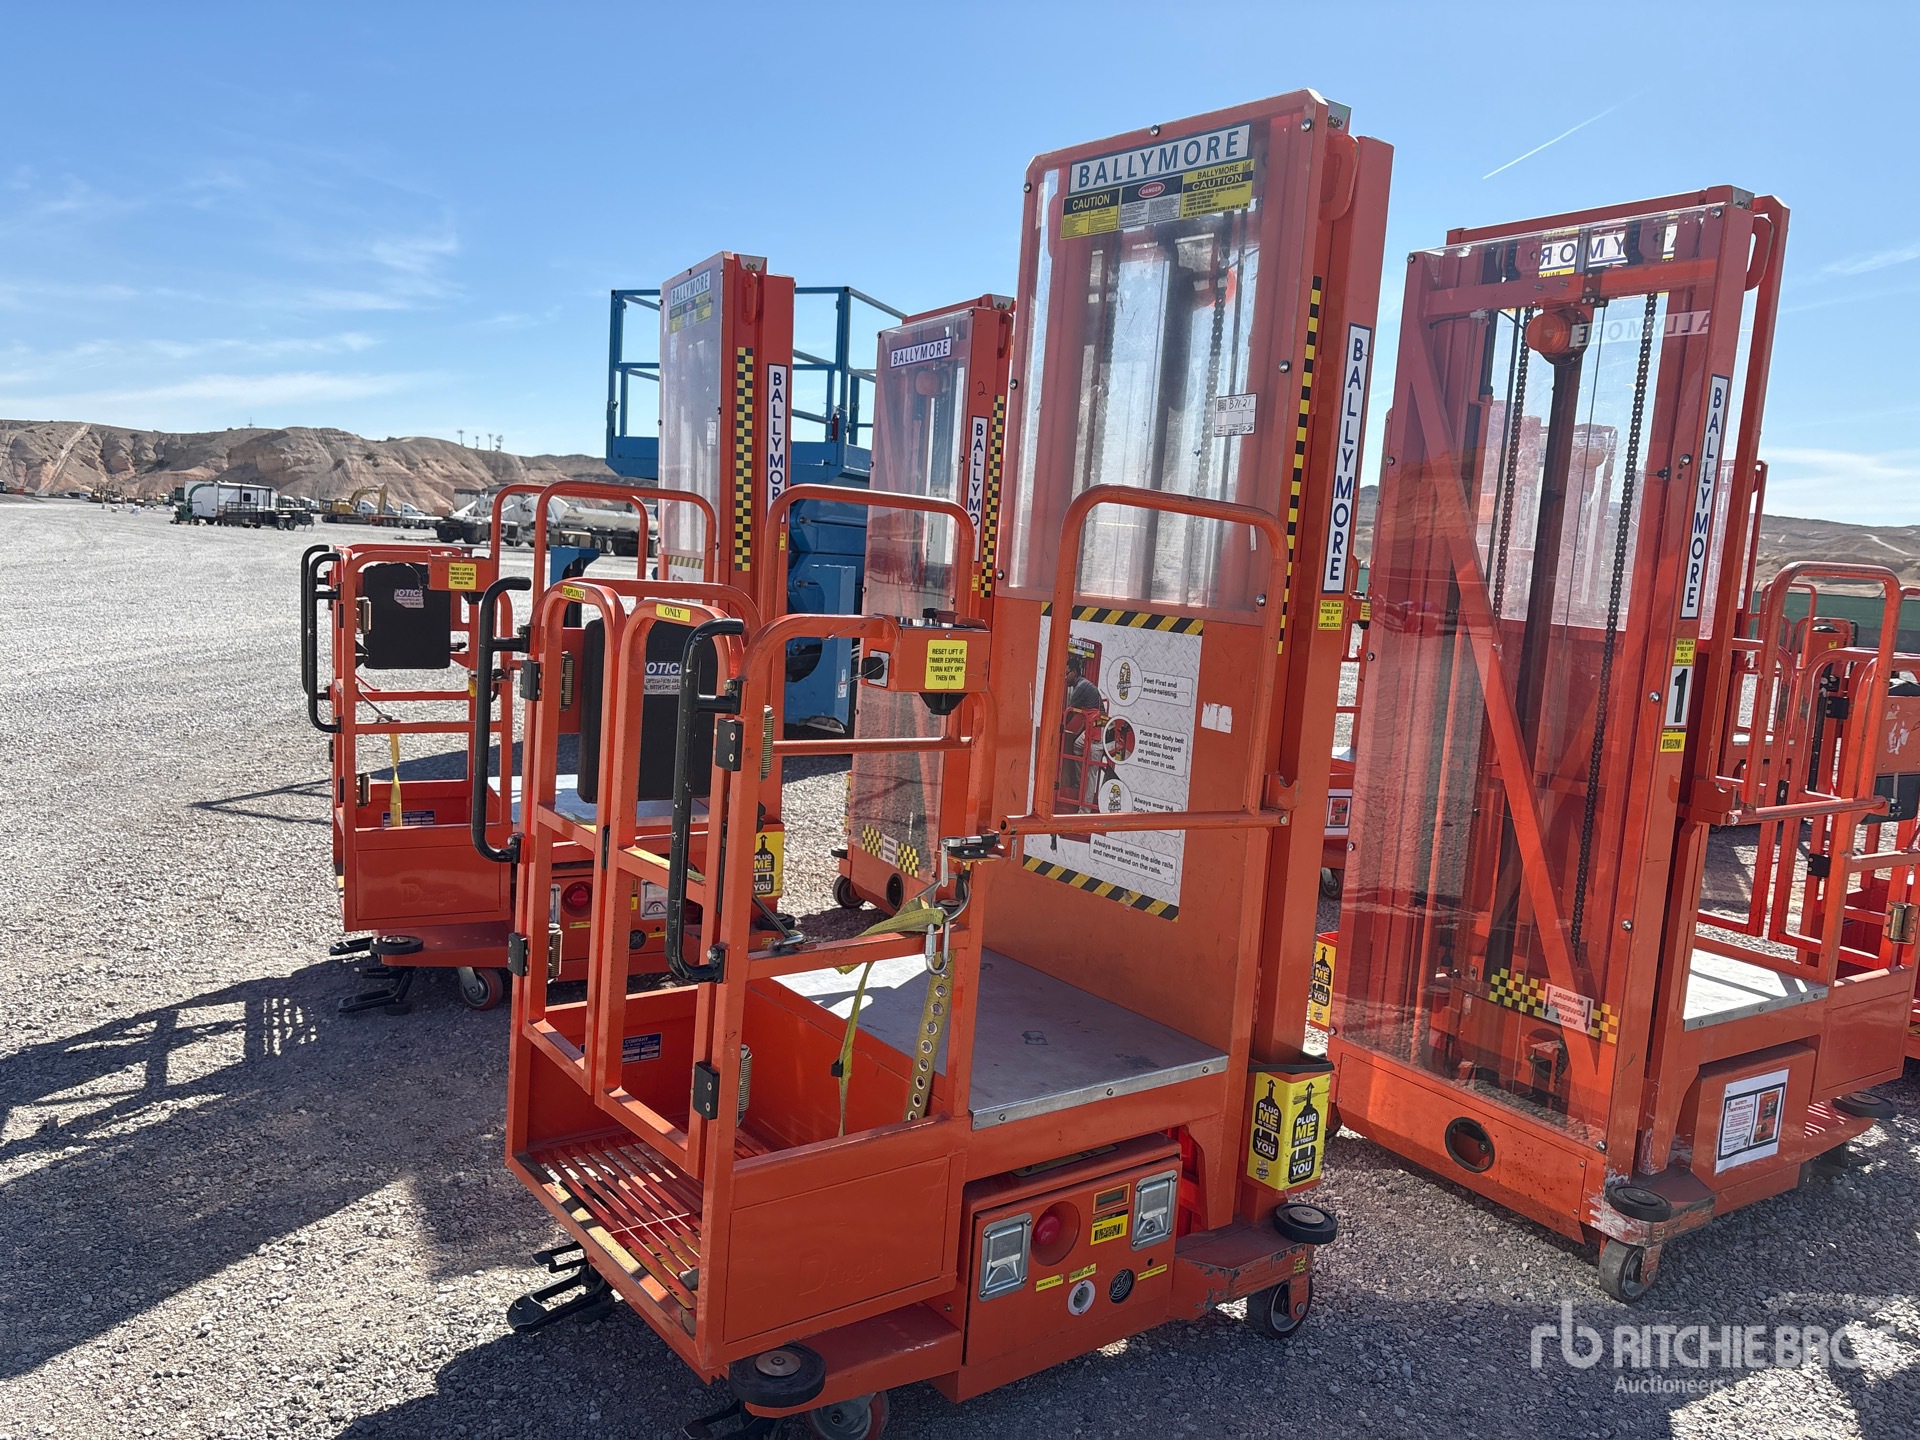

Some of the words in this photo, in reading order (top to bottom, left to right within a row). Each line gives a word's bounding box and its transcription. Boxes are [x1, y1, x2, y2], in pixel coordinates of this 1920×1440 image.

[1078, 130, 1239, 188] BALLYMORE
[1197, 164, 1239, 180] BALLYMORE
[1192, 173, 1243, 191] CAUTION
[1072, 193, 1110, 211] CAUTION
[672, 273, 709, 305] BALLYMORE
[893, 340, 949, 366] BALLYMORE
[977, 381, 988, 396] 2
[770, 371, 784, 500] BALLYMOR
[1329, 337, 1364, 581] BALLYMORE
[969, 423, 984, 527] BALLYMO
[1687, 386, 1722, 609] BALLYMORE
[664, 606, 683, 619] ONLY
[645, 661, 682, 675] OTIC
[1155, 679, 1167, 687] First
[1674, 668, 1688, 723] 1
[1140, 729, 1153, 738] Place
[1162, 734, 1174, 743] body
[1145, 749, 1161, 757] yellow
[1162, 752, 1174, 760] hook
[1149, 741, 1162, 749] static
[1162, 743, 1182, 753] lanyard
[1137, 757, 1150, 765] when
[1134, 796, 1151, 807] Always
[1152, 802, 1164, 810] wear
[1092, 848, 1102, 856] and
[1102, 852, 1116, 860] never
[1117, 856, 1131, 865] stand
[1139, 862, 1148, 871] the
[1093, 839, 1111, 850] Always
[1111, 845, 1124, 853] work
[1124, 849, 1140, 859] within
[1140, 854, 1149, 862] the
[1150, 857, 1161, 865] side
[1161, 861, 1174, 870] rails
[754, 860, 772, 869] ME
[754, 883, 772, 891] YOU
[1315, 963, 1330, 973] PLUG
[1315, 968, 1330, 981] ME
[1313, 992, 1328, 1002] YOU
[1259, 1101, 1279, 1116] PLUG
[1258, 1109, 1278, 1127] ME
[1296, 1112, 1317, 1127] PLUG
[1263, 1121, 1278, 1131] TODAY
[1295, 1121, 1316, 1140] ME
[1300, 1135, 1315, 1144] TODAY
[1256, 1140, 1275, 1155] YOU
[1292, 1160, 1312, 1176] YOU
